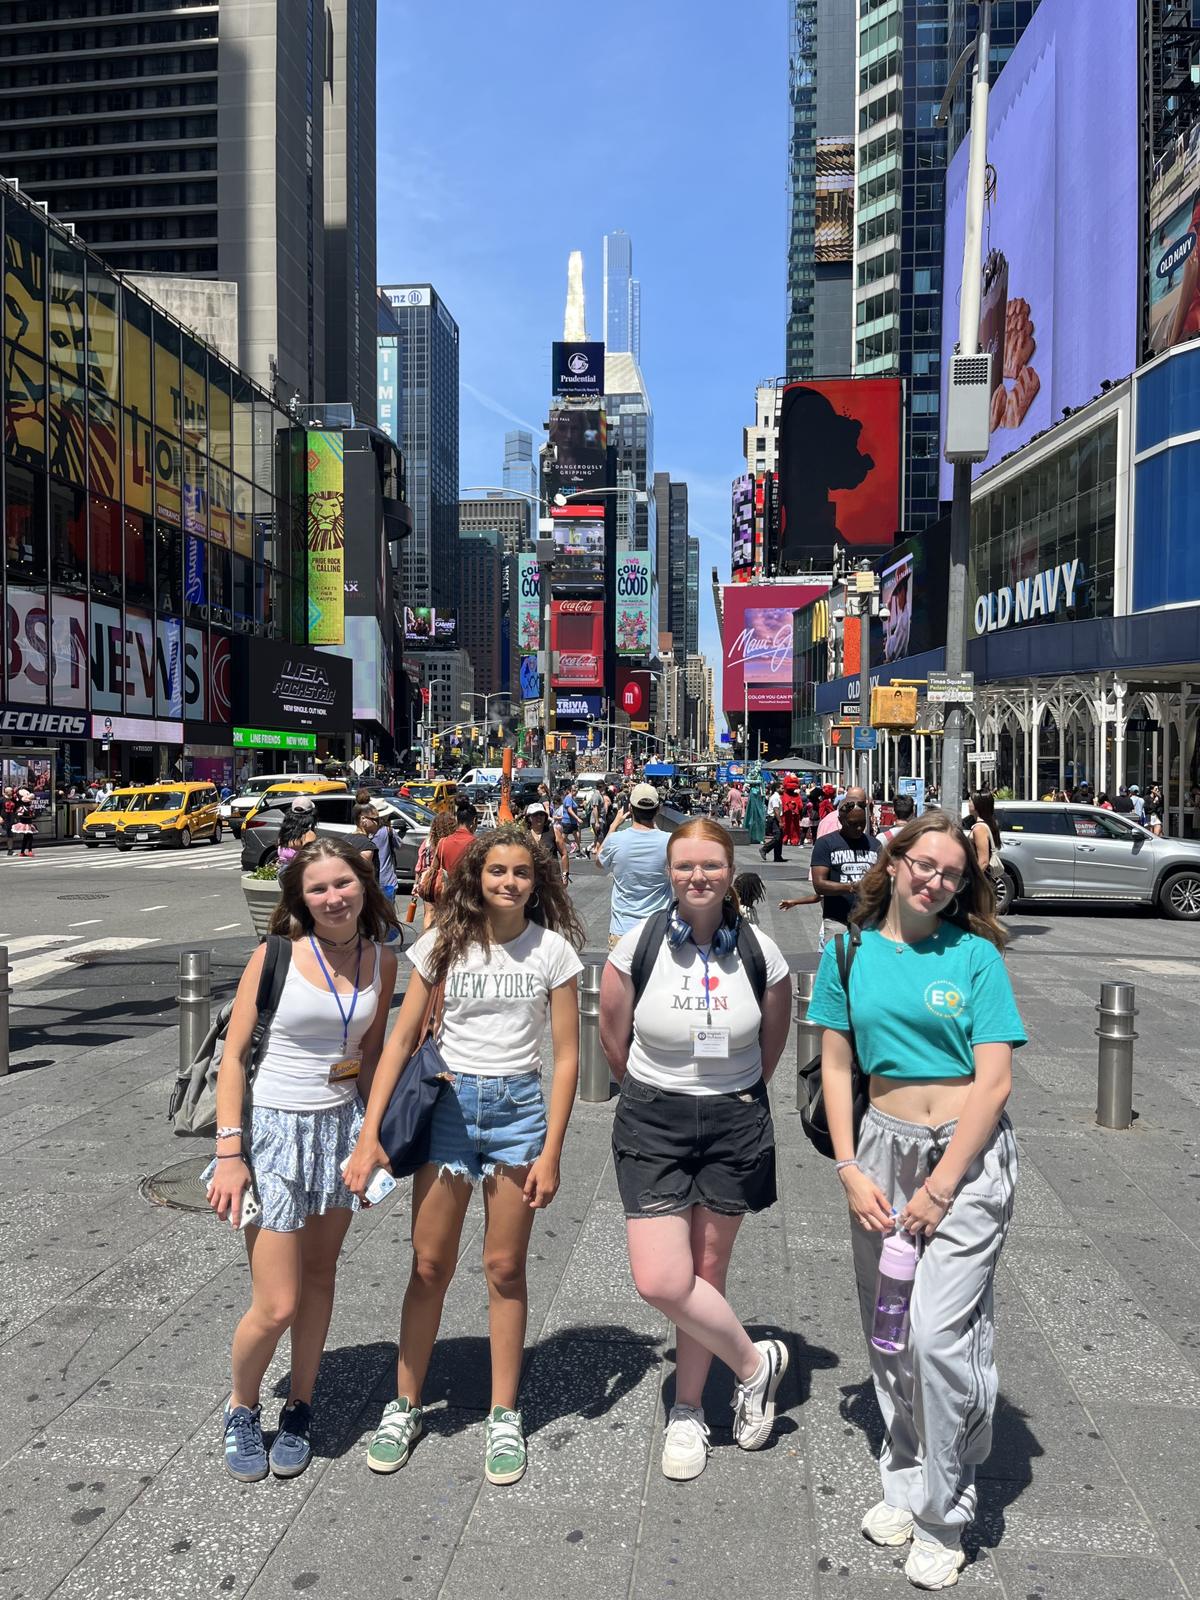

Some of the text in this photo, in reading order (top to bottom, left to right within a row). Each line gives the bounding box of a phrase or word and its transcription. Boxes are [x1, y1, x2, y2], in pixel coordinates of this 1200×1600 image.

[1160, 236, 1192, 274] OLD NAVY
[618, 564, 648, 577] COULD
[618, 576, 648, 596] GOOD
[975, 559, 1079, 635] OLD NAVY
[69, 616, 201, 705] NEWS
[557, 701, 588, 709] TRIVIA
[0, 710, 87, 735] ECHERS
[449, 971, 537, 998] NEW YORK
[681, 975, 691, 991] I
[671, 994, 729, 1011] MEN
